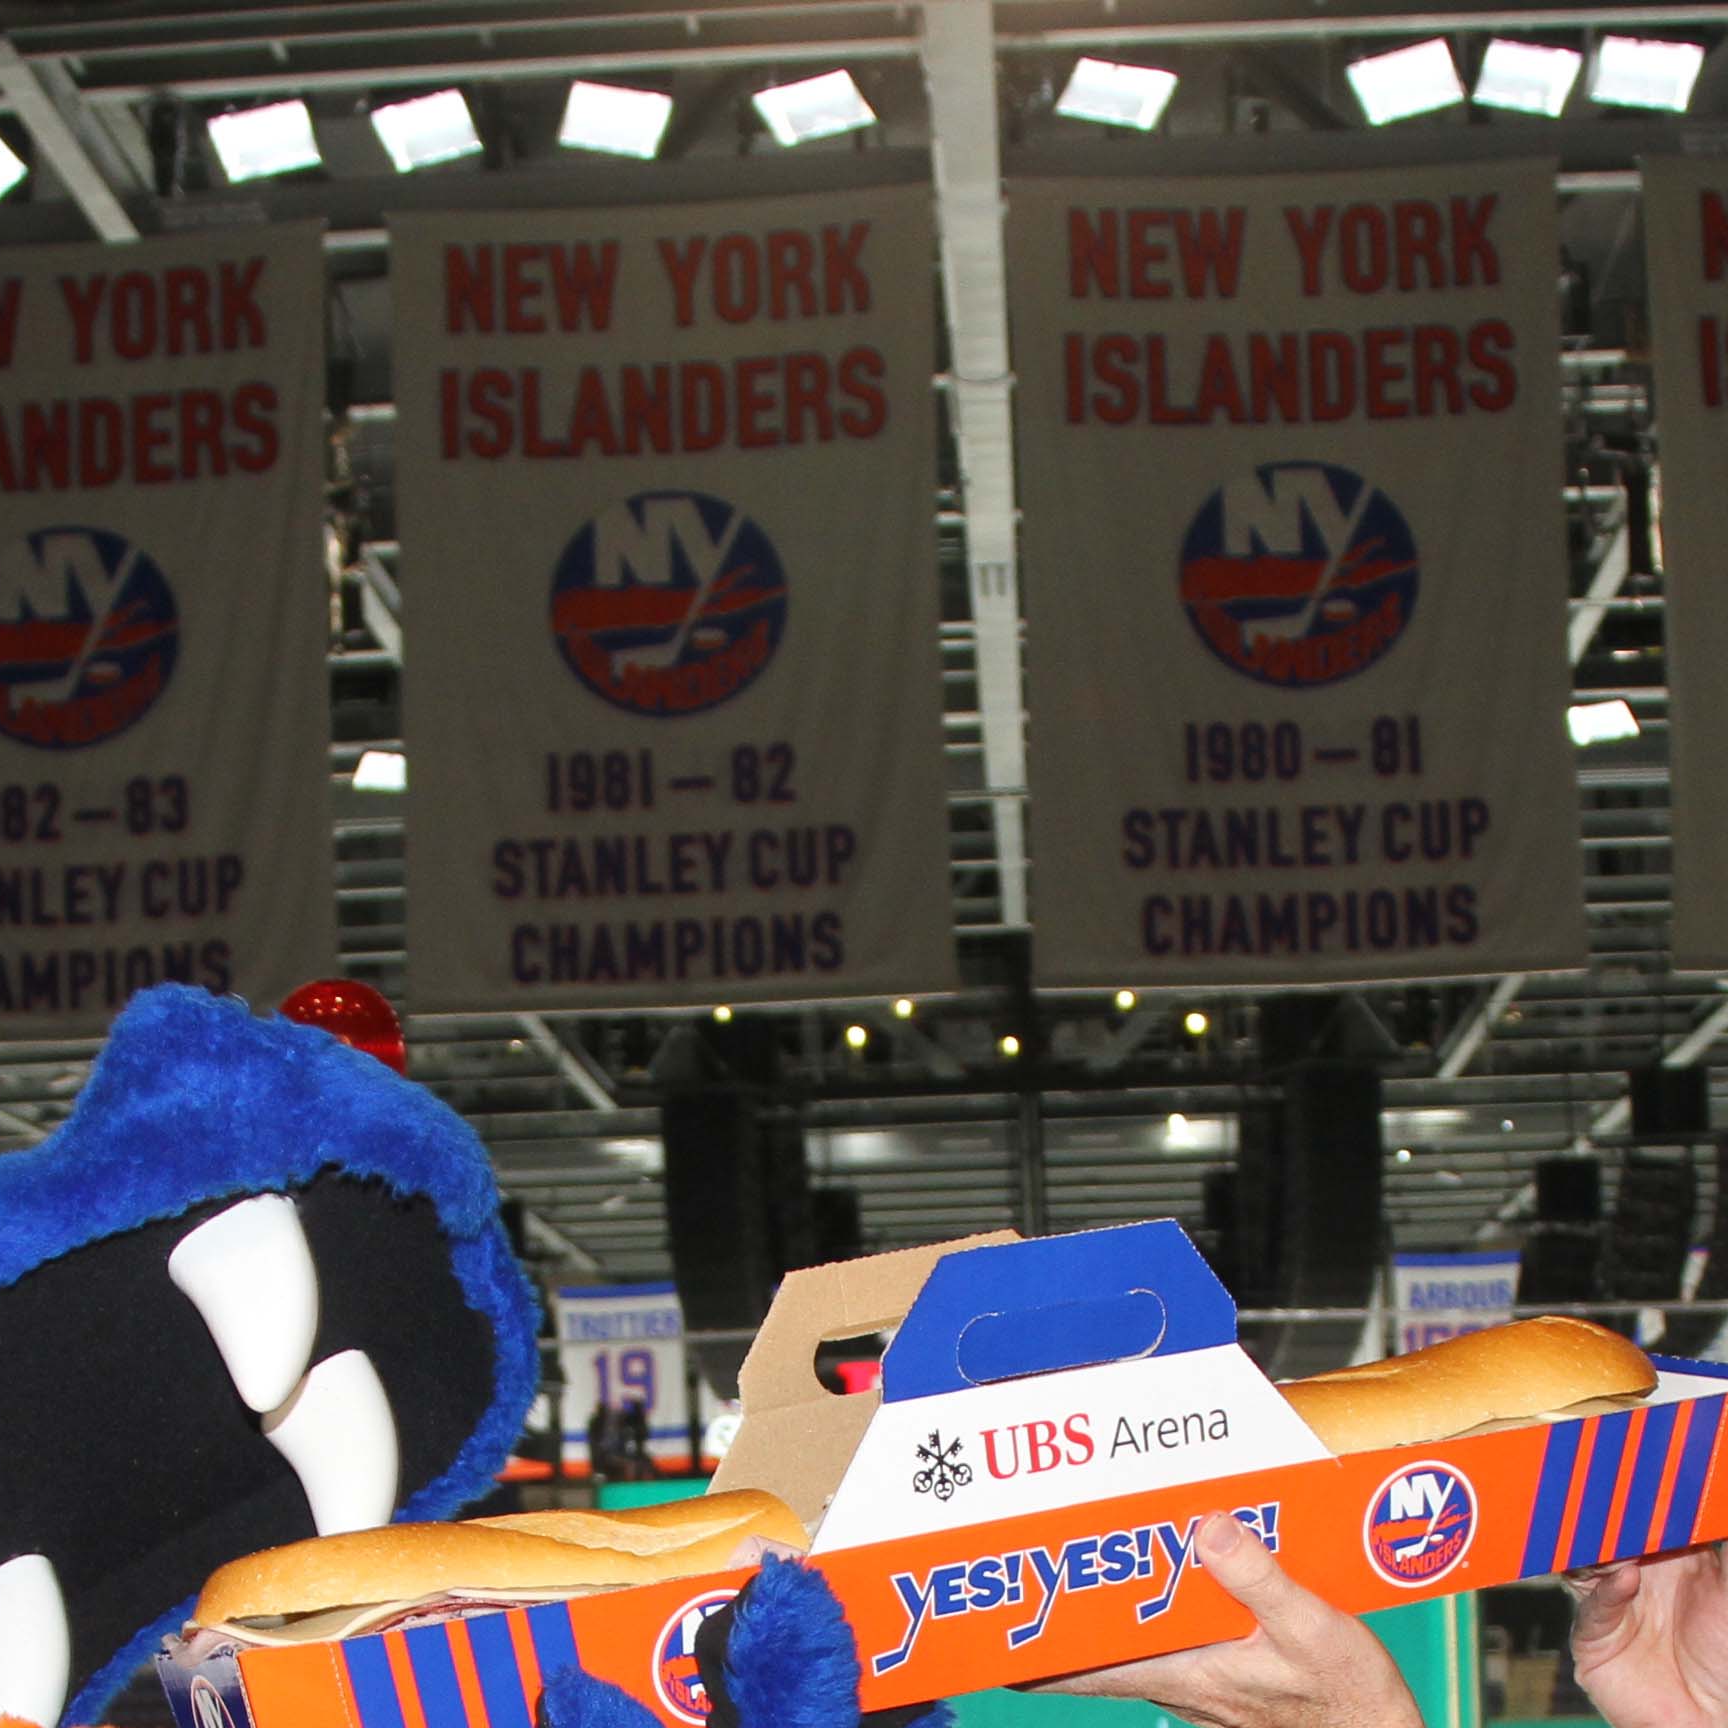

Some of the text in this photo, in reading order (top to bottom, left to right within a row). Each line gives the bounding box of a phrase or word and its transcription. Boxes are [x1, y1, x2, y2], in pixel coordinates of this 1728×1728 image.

[443, 220, 874, 336] NEW YORK
[1066, 192, 1502, 301] NEW YORK
[57, 256, 269, 365] YORK
[440, 348, 889, 461] ISLANDERS
[1065, 318, 1518, 427] ISLANDERS
[594, 498, 746, 586] NY
[1224, 468, 1373, 554] NY
[493, 823, 858, 902] STANLEY CUP
[1122, 798, 1492, 870] STANLEY CUP
[139, 854, 245, 919] CUP
[1143, 884, 1479, 959] CHAMPIONS
[510, 913, 845, 987] CHAMPIONS
[1408, 1279, 1510, 1310] ARBOUR
[593, 1345, 657, 1413] 19
[979, 1408, 1229, 1480] UBS Arena
[1389, 1472, 1456, 1522] NY
[1374, 1528, 1464, 1575] ISLANDERS
